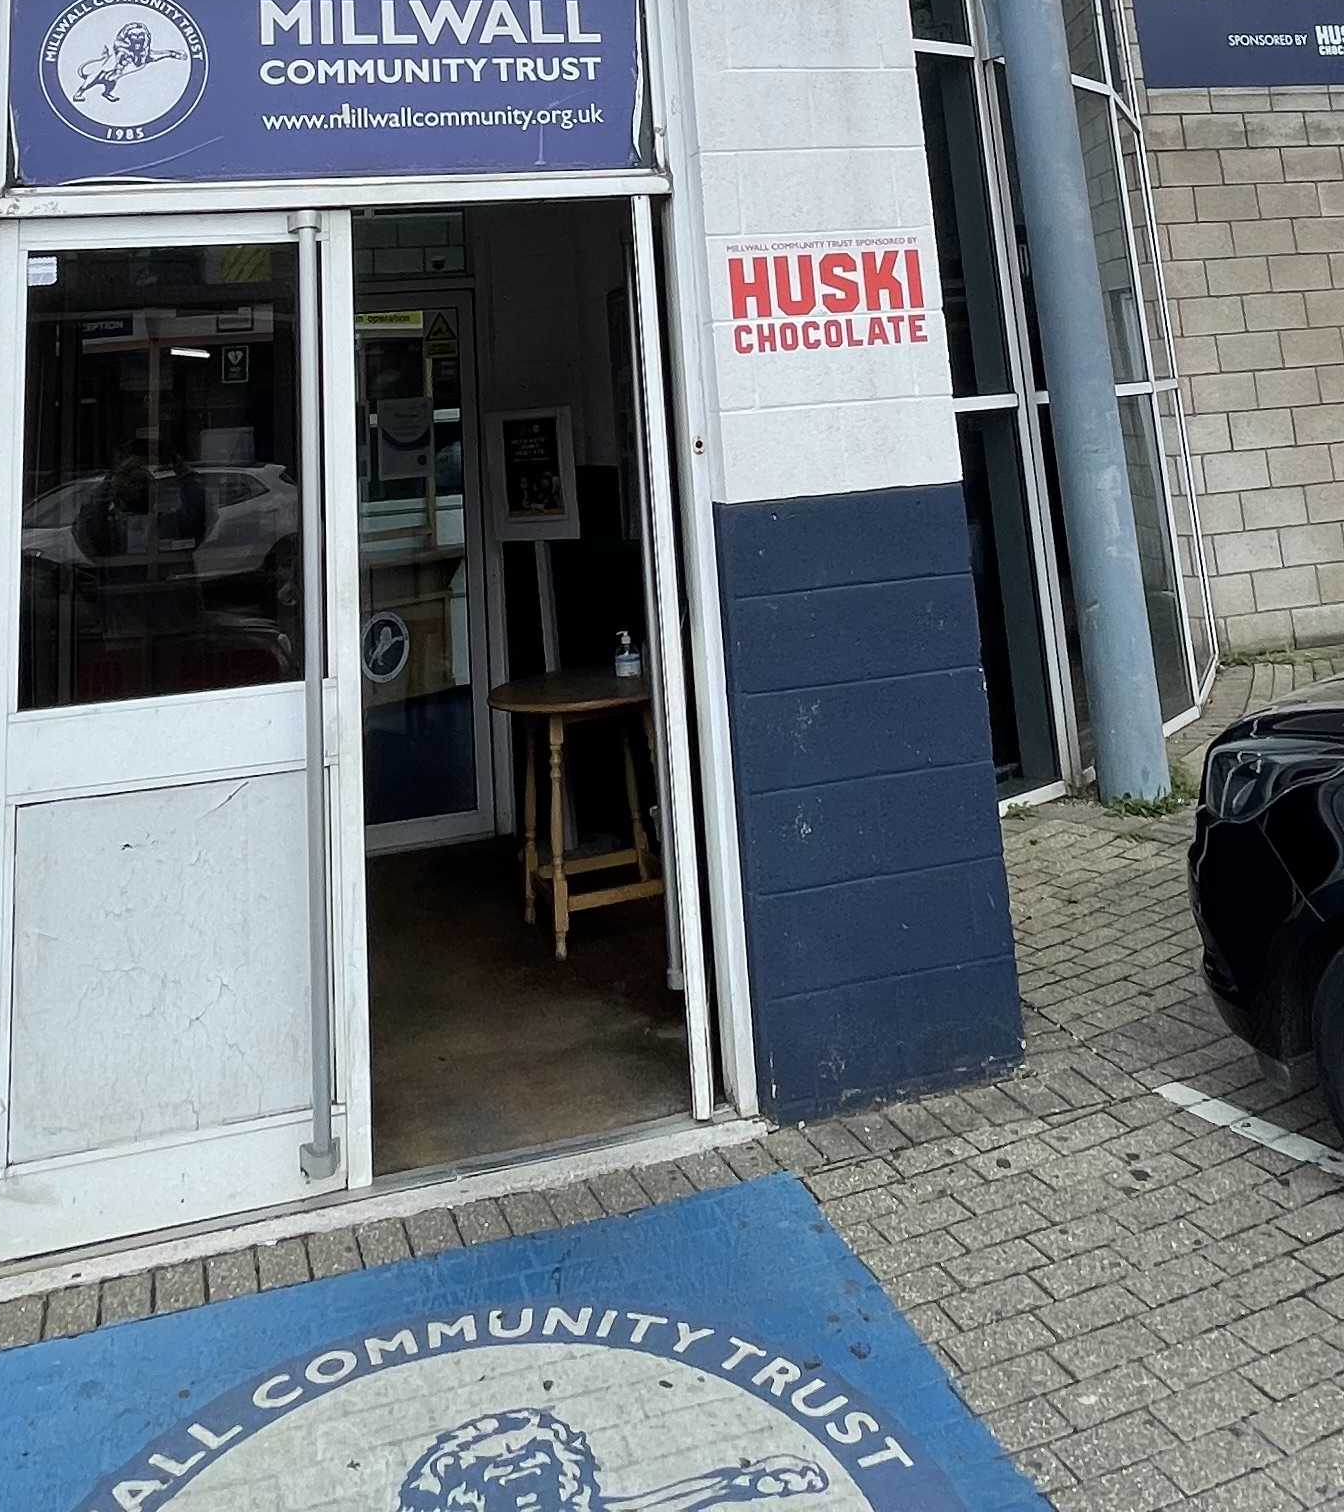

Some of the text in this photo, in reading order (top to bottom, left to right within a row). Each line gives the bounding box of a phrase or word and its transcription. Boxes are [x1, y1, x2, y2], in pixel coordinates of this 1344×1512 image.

[46, 3, 92, 62] MILLWALL
[178, 19, 203, 60] TRUST
[260, 0, 602, 45] MILLWALL
[1228, 33, 1308, 46] SPONSORED BY
[260, 56, 602, 85] COMMUNITY TRUST
[106, 127, 144, 140] 1985
[261, 103, 604, 131] www.millwallcommunity.org.uk
[726, 237, 918, 253] MILLWALL COMMUNITY TRUST SPONSORED BY
[728, 250, 924, 319] HUSKI
[734, 314, 929, 355] CHOCOLATE
[252, 1306, 914, 1469] COMMUNITY TRUST
[89, 1422, 244, 1512] ALL
